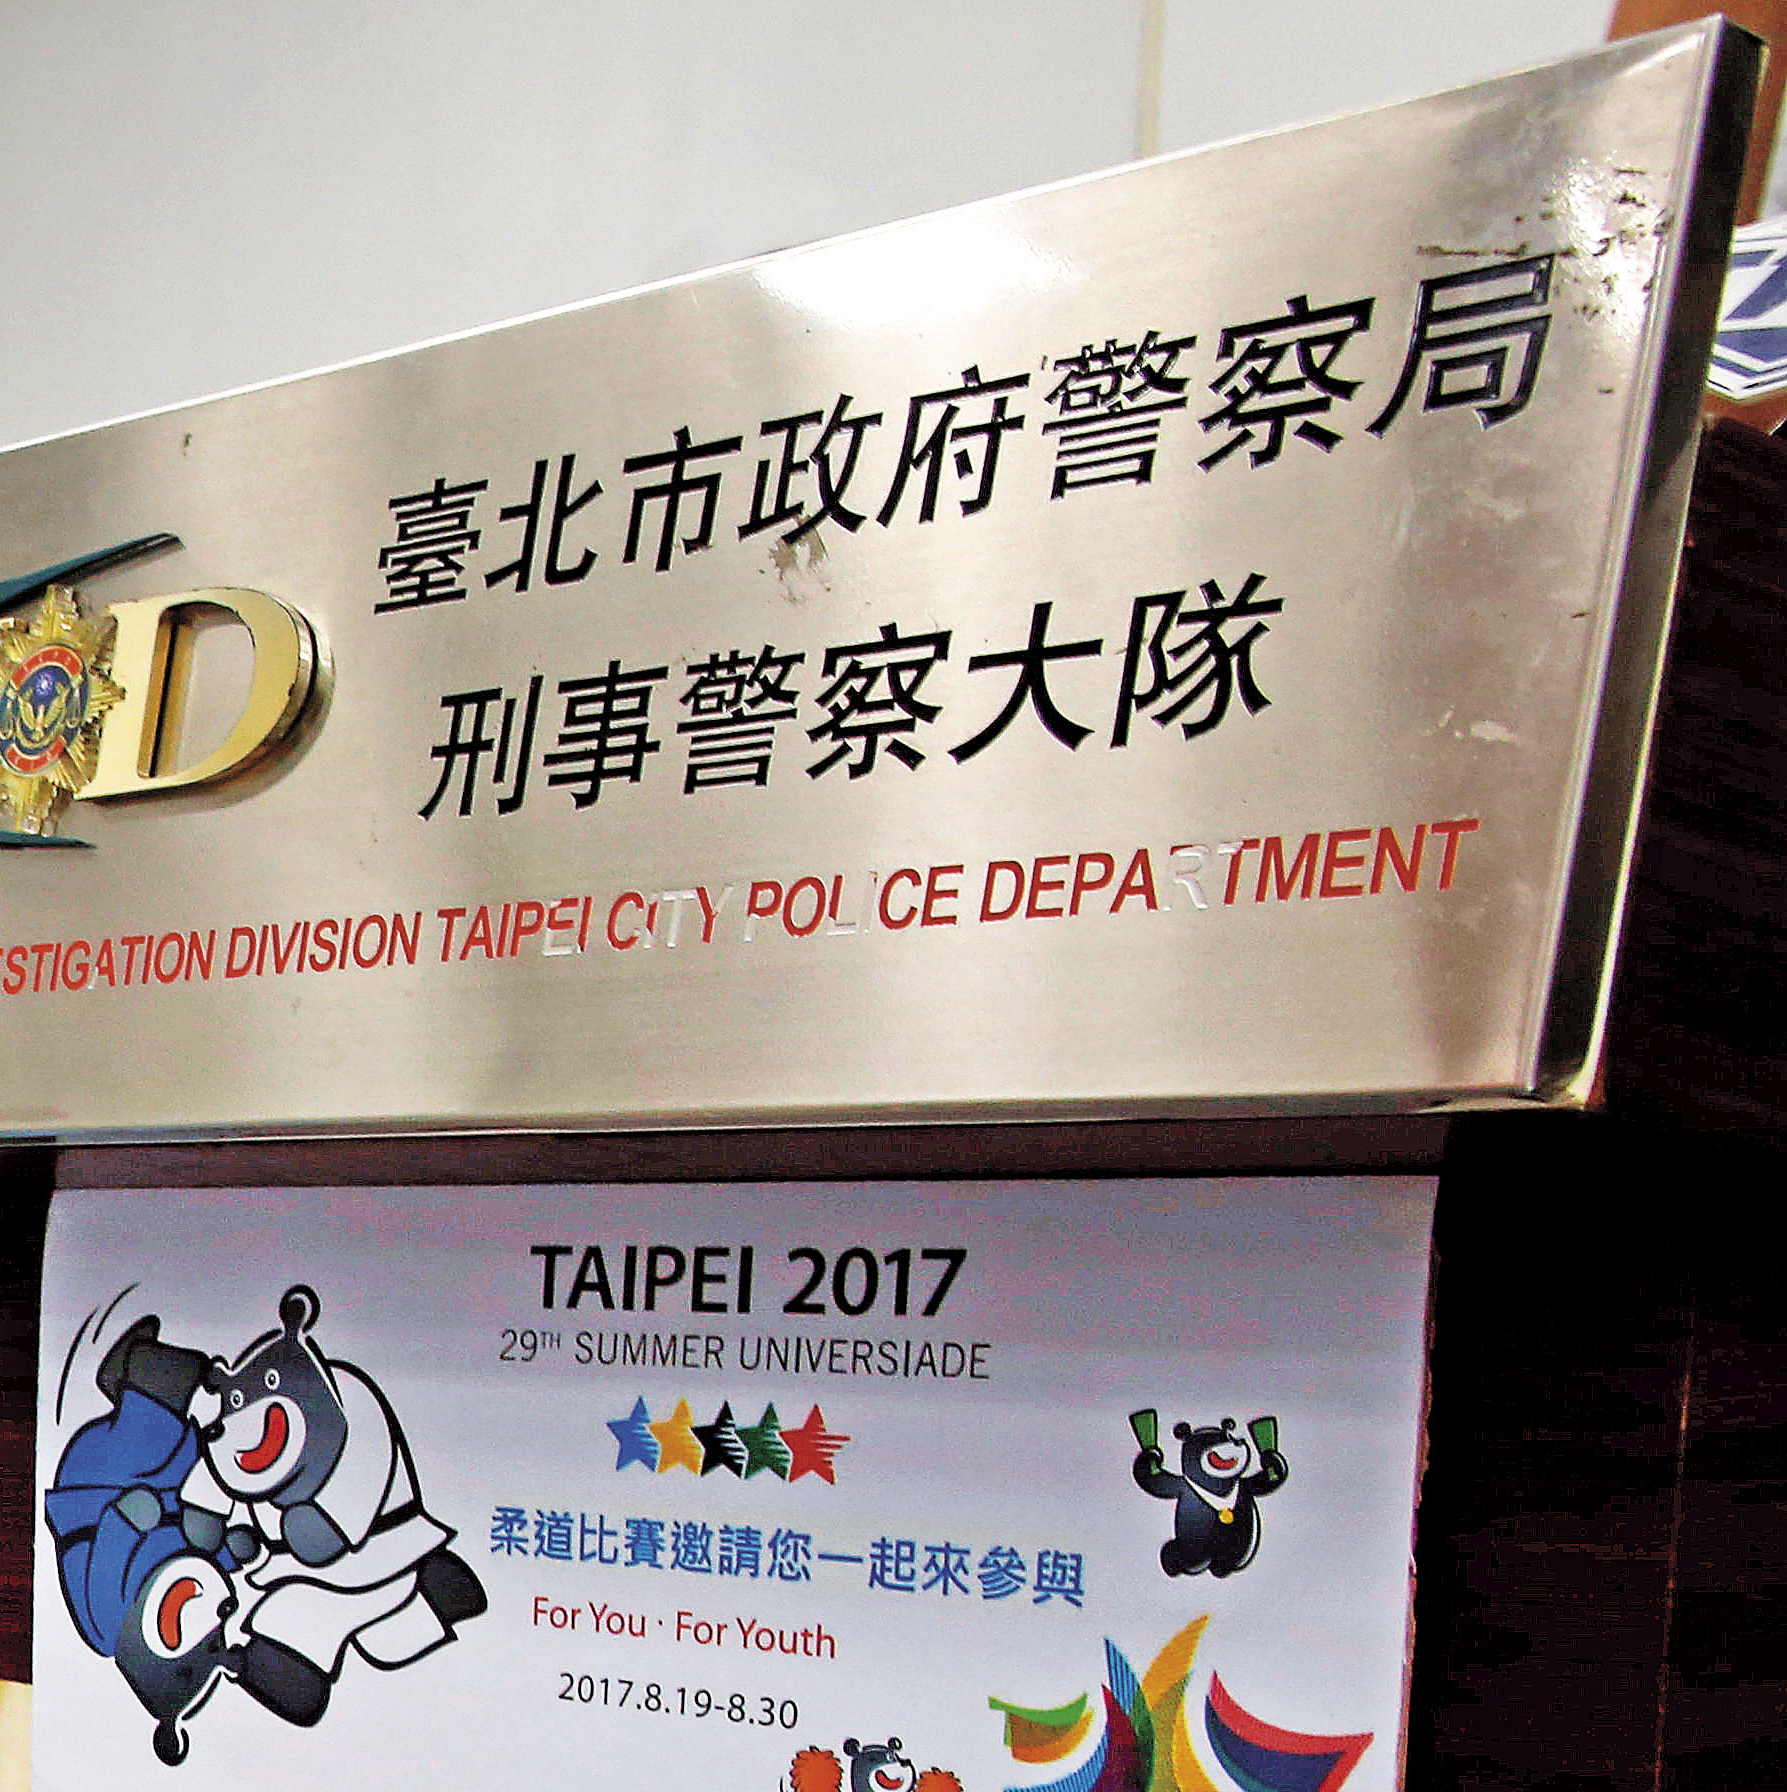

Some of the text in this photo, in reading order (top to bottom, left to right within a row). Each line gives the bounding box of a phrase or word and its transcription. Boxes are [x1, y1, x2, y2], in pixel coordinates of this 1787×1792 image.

[373, 256, 1557, 617] 臺北市政府警察局
[416, 570, 1284, 821] 刑事警察大隊
[226, 910, 421, 980] DIVISION
[435, 890, 591, 961] TAIPEI
[606, 882, 734, 950] CITY
[742, 861, 964, 943] POLICE
[978, 816, 1480, 925] DEPARTMENT
[530, 1245, 968, 1317] TAIPEI 2017
[498, 1329, 993, 1380] 29TH SUMMER UNIVERSIADE
[489, 1506, 1085, 1608] 柔道比賽邀請您一起來參與
[532, 1597, 838, 1660] For You For Youth
[558, 1672, 799, 1729] 2017.8.19-8.30
